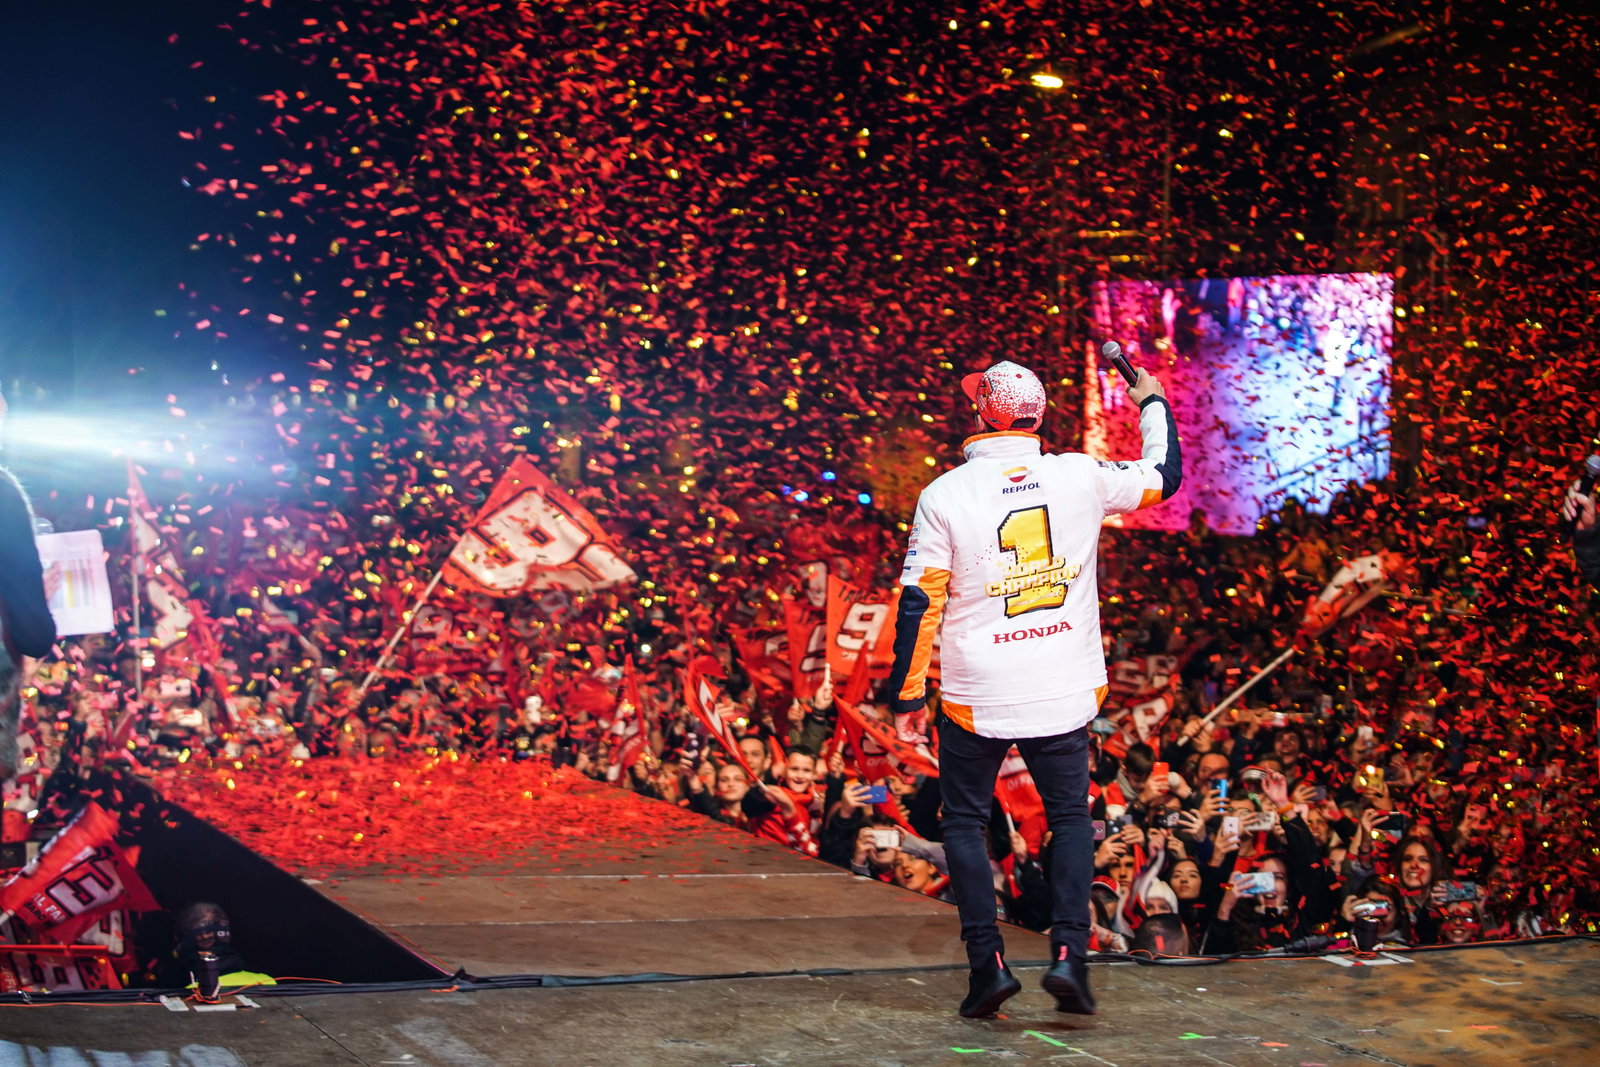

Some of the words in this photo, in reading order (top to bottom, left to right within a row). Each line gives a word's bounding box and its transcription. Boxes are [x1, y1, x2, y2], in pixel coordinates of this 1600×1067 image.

[1002, 482, 1040, 494] REPSOL
[997, 504, 1068, 618] 1
[985, 565, 1082, 597] CHAMPION
[993, 621, 1072, 643] HONDA
